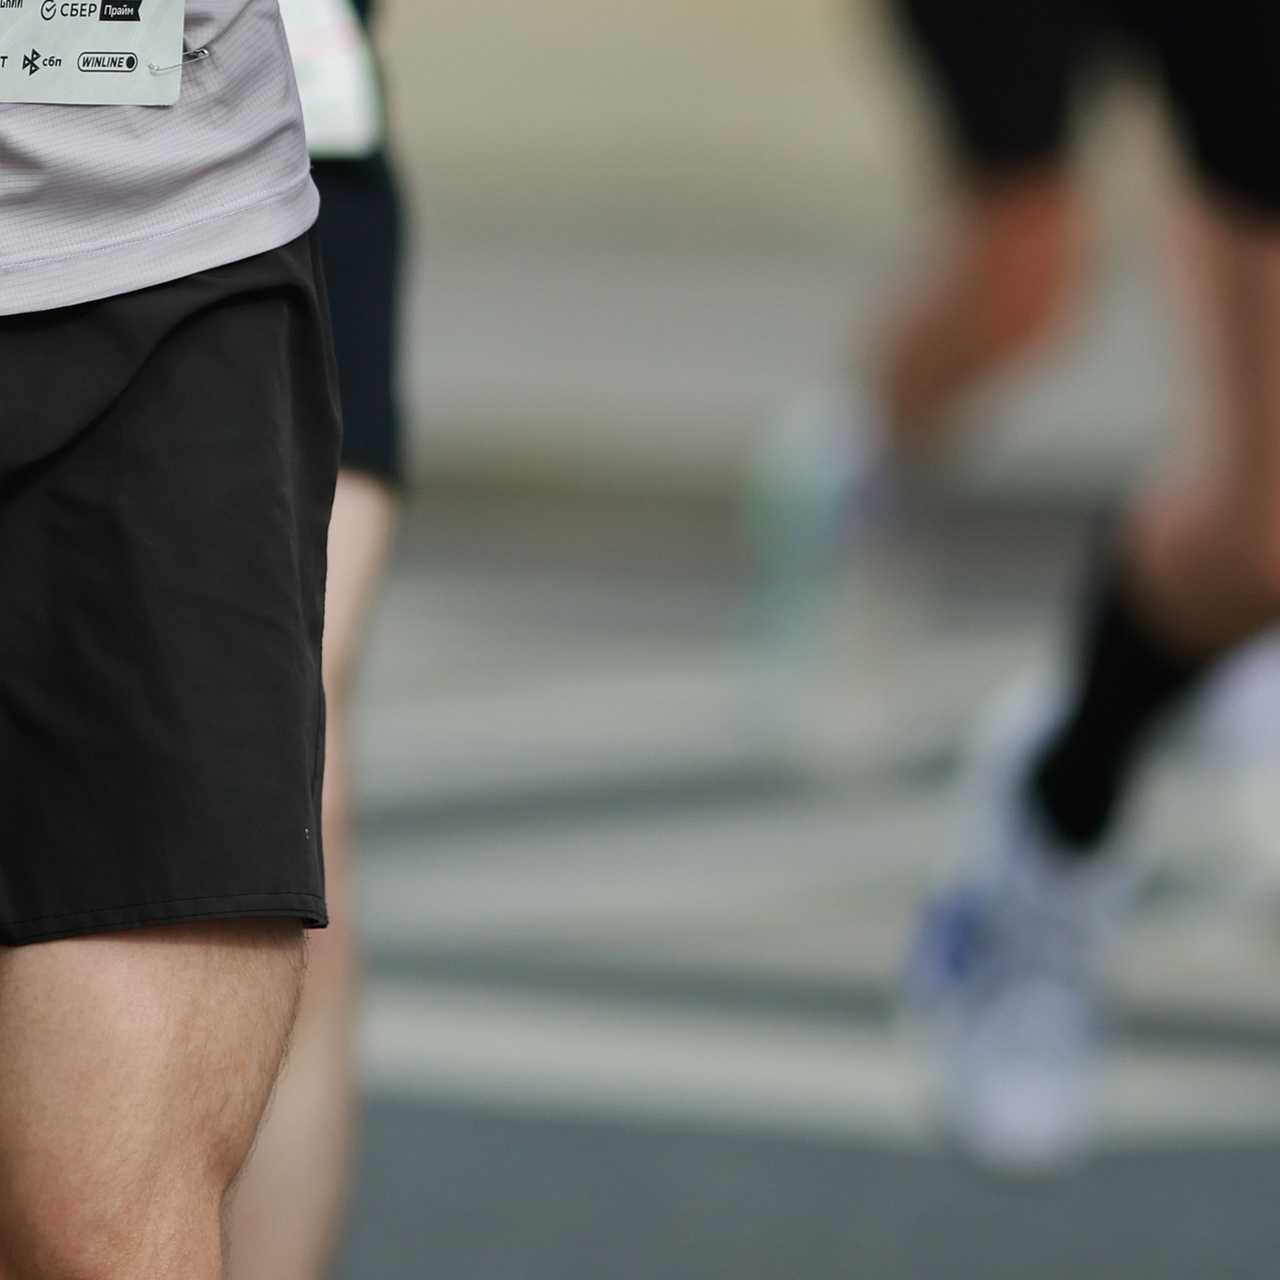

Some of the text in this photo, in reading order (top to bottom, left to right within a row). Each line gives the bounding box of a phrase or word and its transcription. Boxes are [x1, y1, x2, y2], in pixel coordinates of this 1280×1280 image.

[60, 3, 135, 17] СБЕР Прайм
[82, 56, 125, 68] WINLINE
